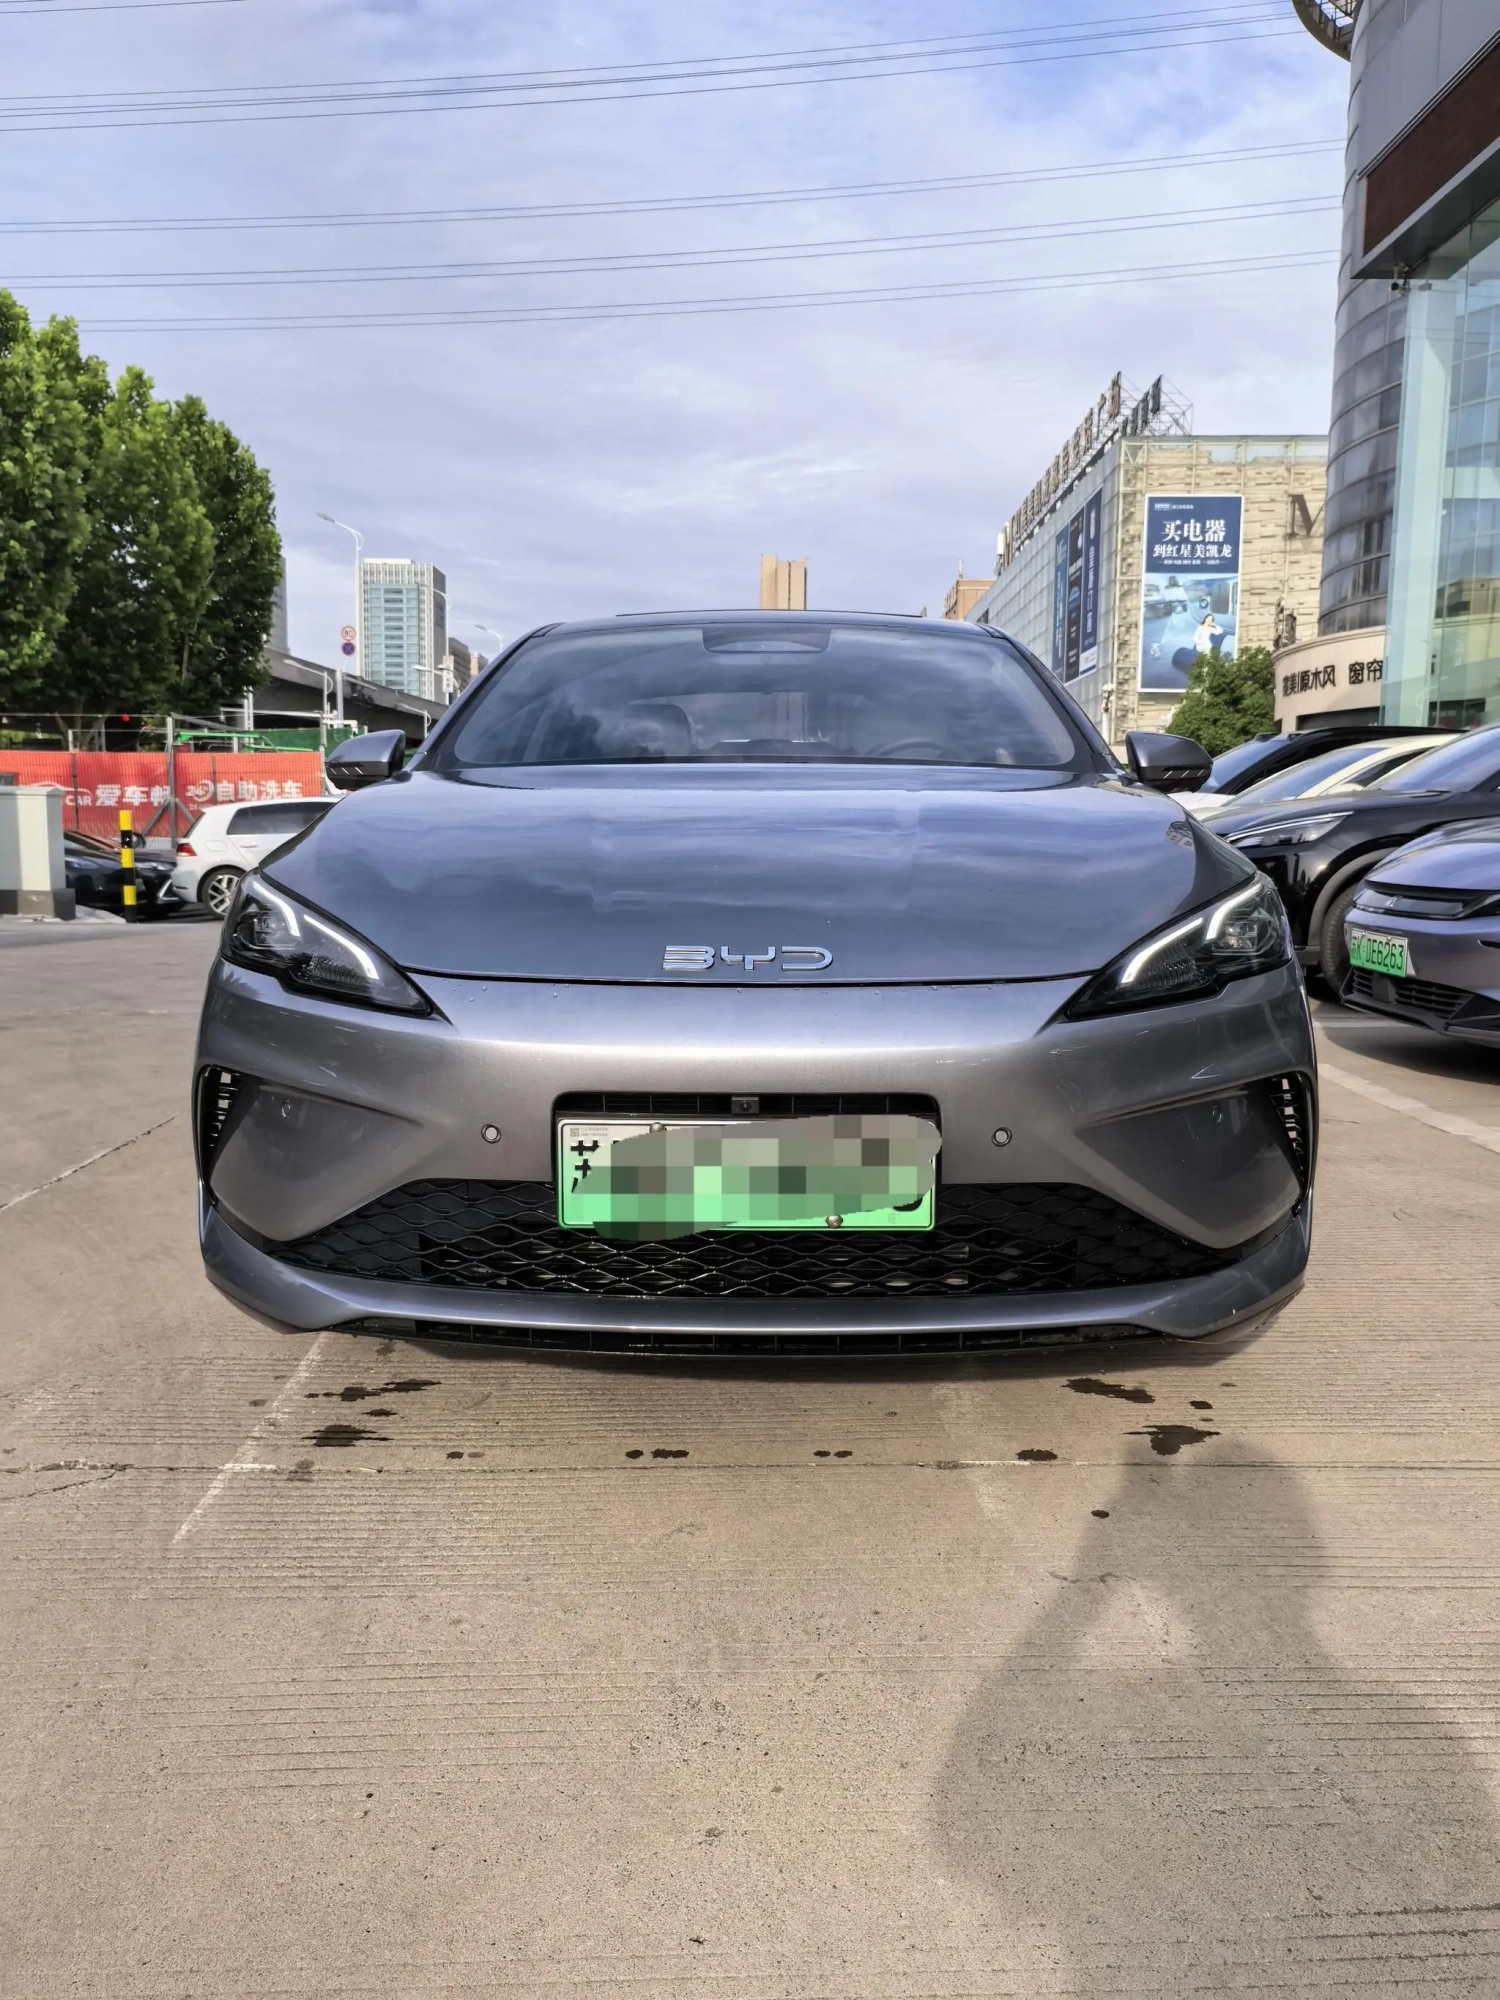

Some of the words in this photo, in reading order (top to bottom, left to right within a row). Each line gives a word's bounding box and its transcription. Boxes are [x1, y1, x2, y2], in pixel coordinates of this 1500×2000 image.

[1161, 519, 1226, 542] 买电器
[1153, 543, 1232, 558] 到红星美凯龙
[1348, 658, 1384, 685] 窗帘
[216, 779, 303, 802] 自助洗车
[662, 944, 834, 971] BYD
